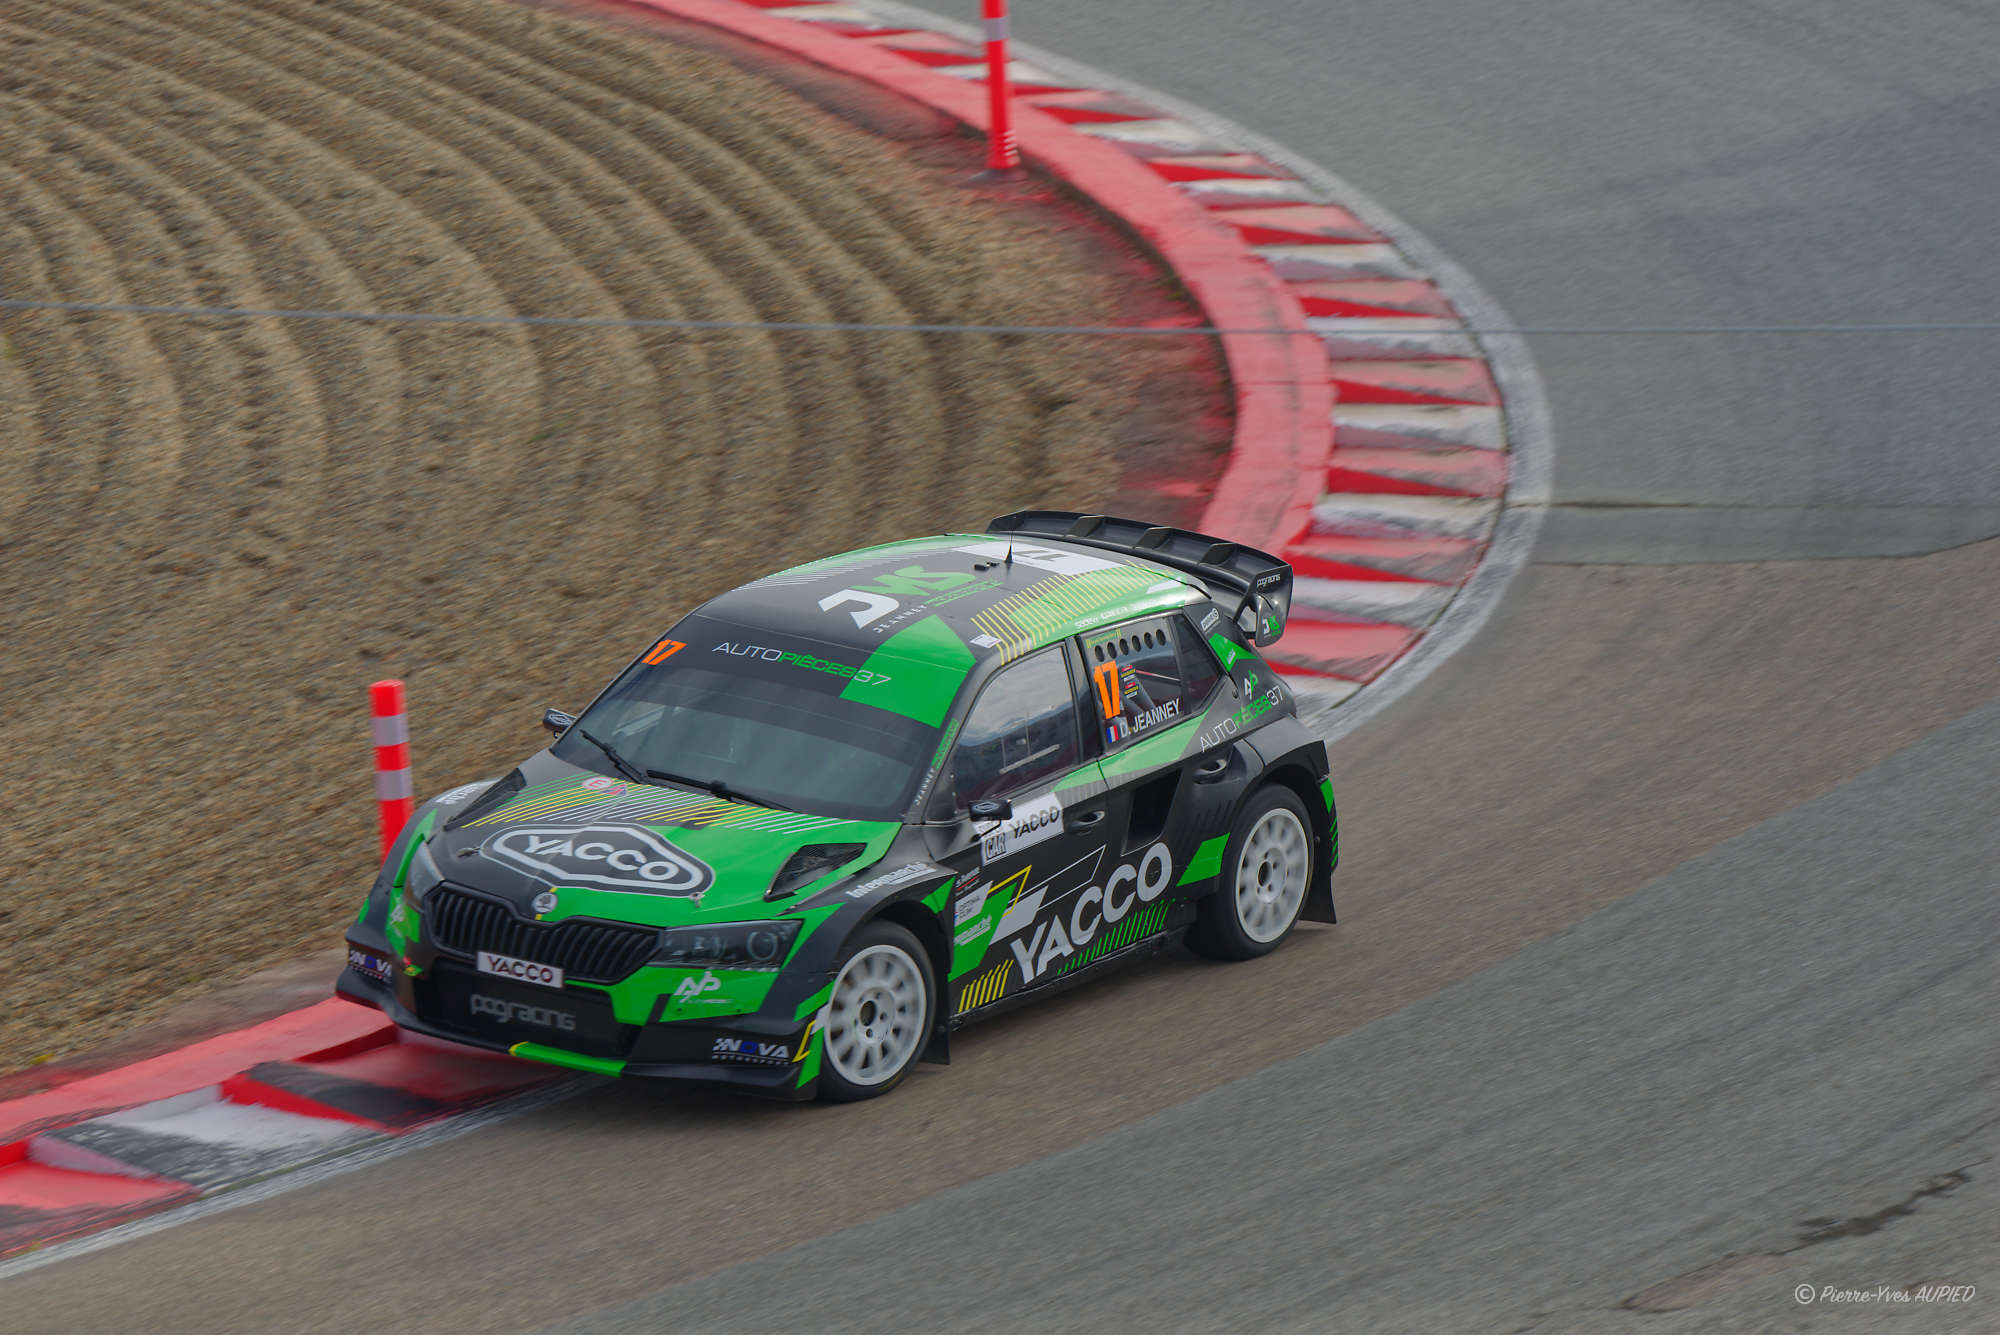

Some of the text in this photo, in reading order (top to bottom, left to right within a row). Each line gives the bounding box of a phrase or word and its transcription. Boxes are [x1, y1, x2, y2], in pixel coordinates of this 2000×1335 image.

[642, 640, 687, 665] 17
[1094, 660, 1120, 719] 17
[1133, 698, 1180, 733] JEANNEY
[1009, 806, 1060, 839] YACCO
[525, 835, 679, 881] YACCO
[1010, 842, 1173, 985] YACCO
[488, 955, 553, 983] YACCO
